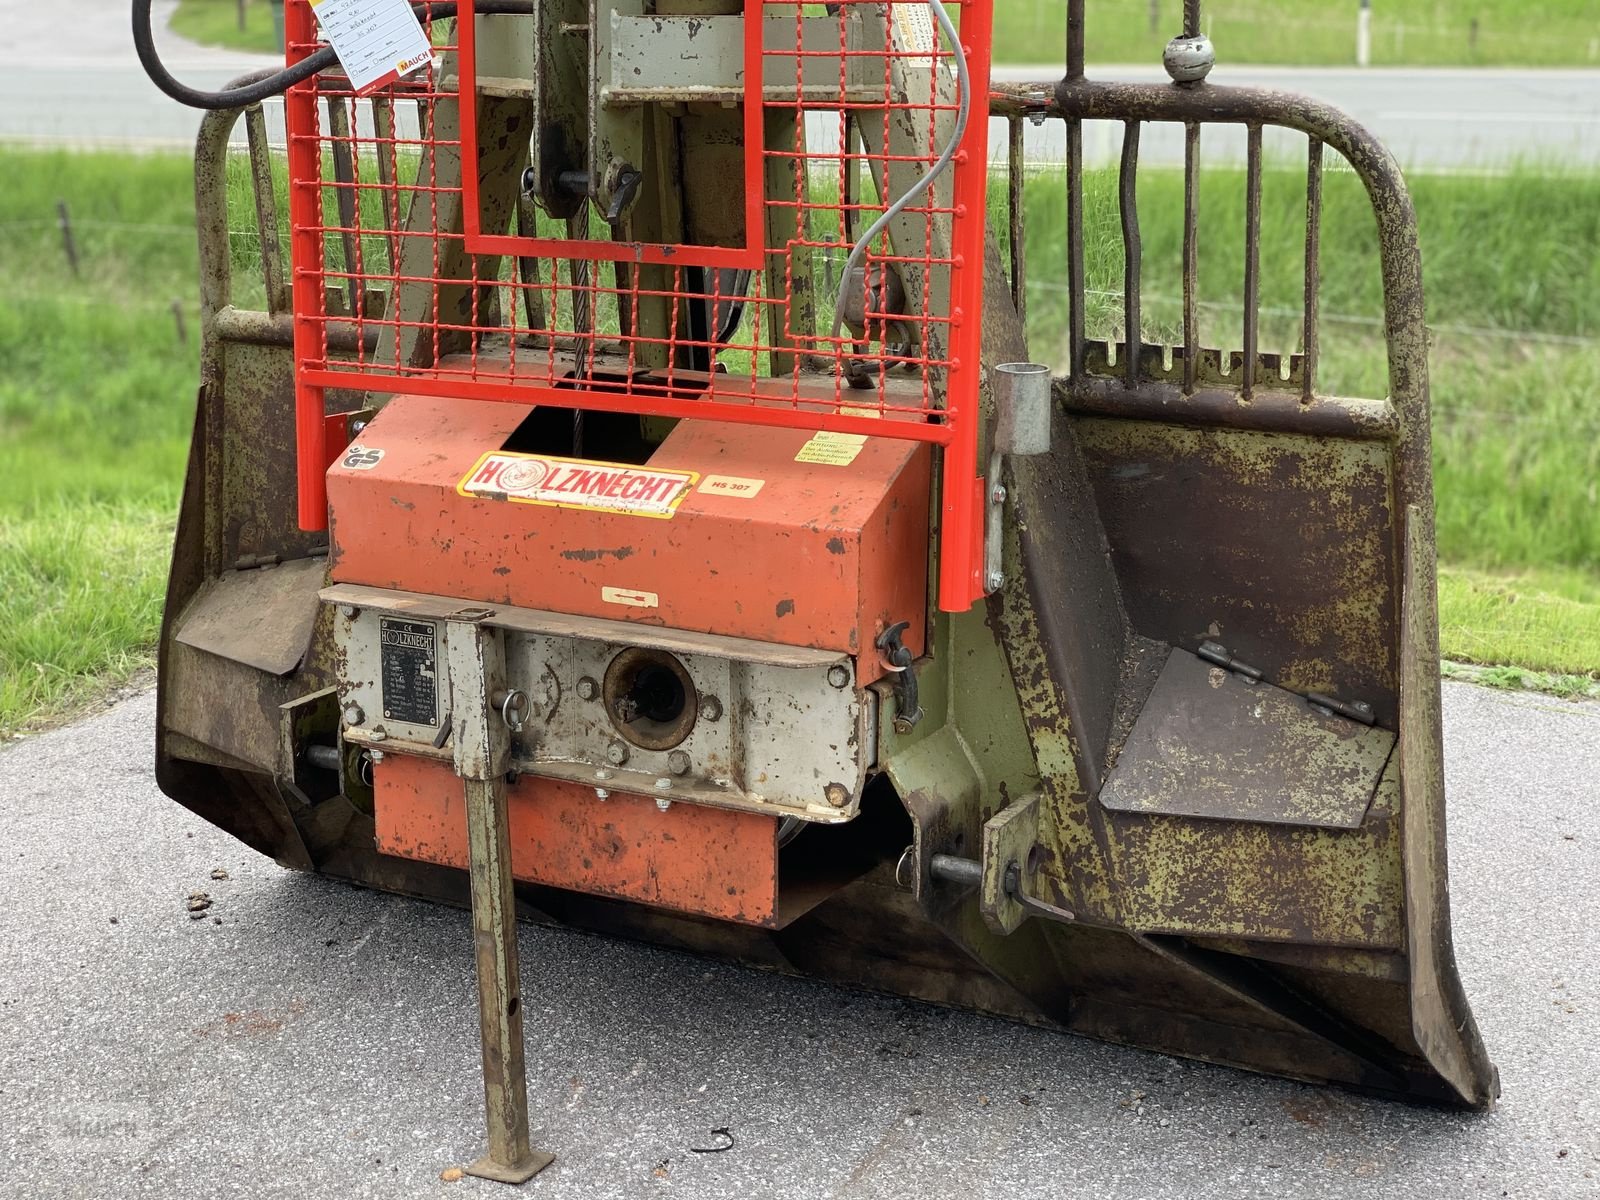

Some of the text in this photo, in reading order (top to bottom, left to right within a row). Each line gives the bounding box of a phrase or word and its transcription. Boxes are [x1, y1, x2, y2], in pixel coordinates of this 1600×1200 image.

[400, 51, 429, 71] MAUCH
[711, 481, 752, 491] HS 307
